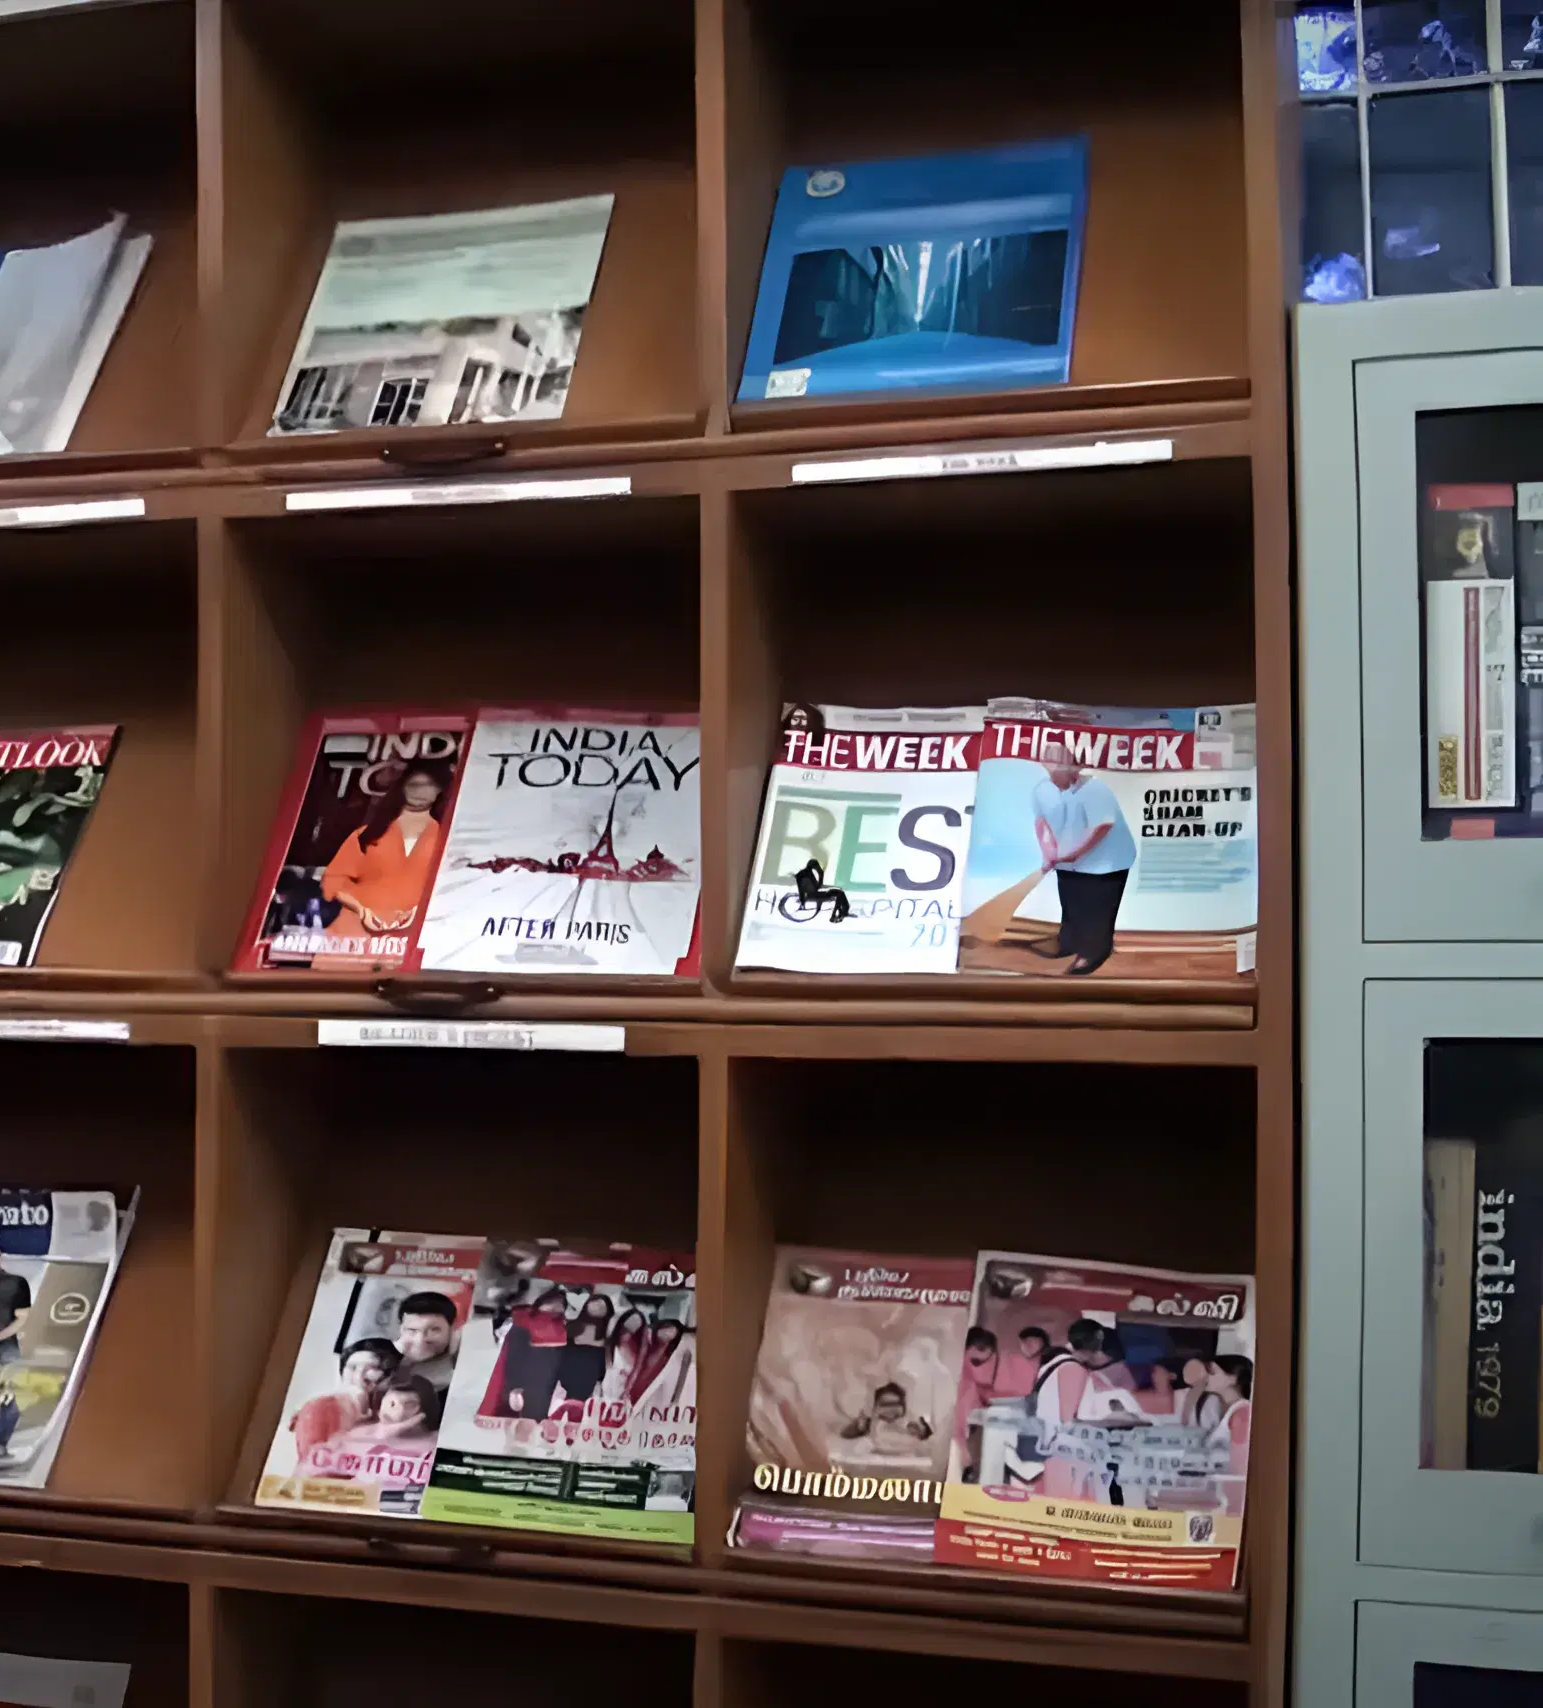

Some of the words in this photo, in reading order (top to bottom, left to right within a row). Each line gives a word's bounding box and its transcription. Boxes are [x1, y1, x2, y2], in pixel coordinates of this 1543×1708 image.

[529, 727, 664, 757] INDIA
[855, 735, 972, 770] WEEK
[488, 750, 700, 792] TODAY
[757, 800, 974, 892] BES
[754, 888, 964, 922] HOPITAL
[481, 916, 556, 940] AFTER
[566, 919, 632, 945] PARIS
[753, 1463, 942, 1504] பொம்மலா
